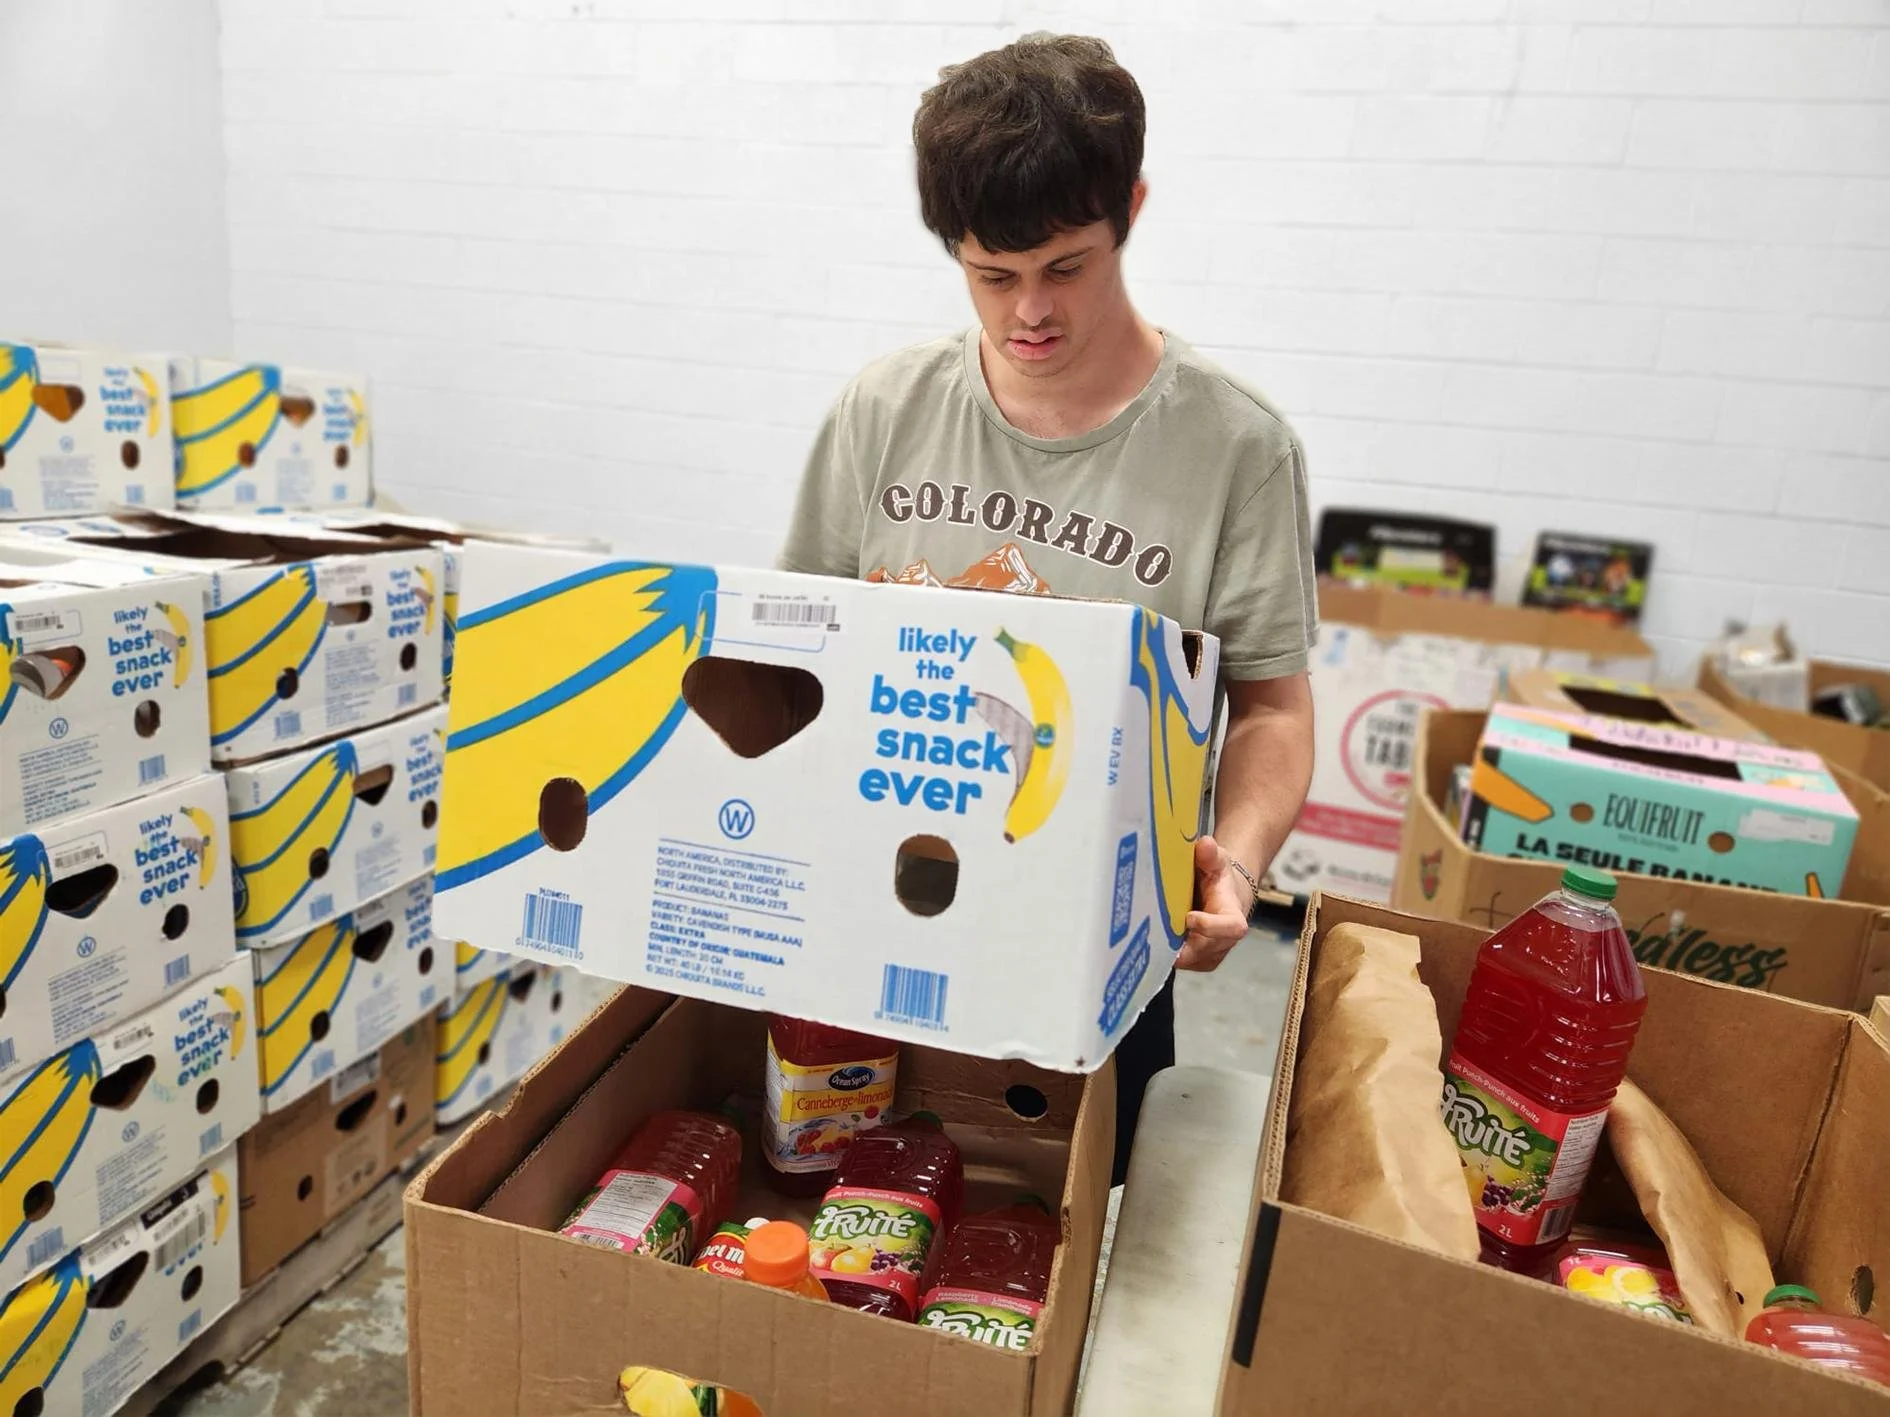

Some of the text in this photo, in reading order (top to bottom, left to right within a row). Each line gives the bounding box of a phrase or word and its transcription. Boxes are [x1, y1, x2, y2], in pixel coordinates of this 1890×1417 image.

[880, 481, 1173, 587] COLORADO
[114, 606, 148, 624] likely
[108, 630, 154, 656] best
[898, 627, 978, 661] likely
[116, 646, 172, 674] snack
[916, 660, 954, 680] the
[112, 671, 164, 696] ever
[870, 674, 977, 724] best
[876, 728, 1012, 774] snack
[859, 768, 982, 814] ever
[140, 814, 172, 834] likely
[1603, 793, 1706, 845] EQUIFRUIT
[134, 836, 180, 867] best
[143, 848, 198, 884] snack
[1515, 833, 1551, 856] LA
[1555, 841, 1646, 874] SEULE
[140, 873, 190, 905] ever
[179, 996, 208, 1021] likely
[174, 1016, 216, 1052] best
[181, 1028, 229, 1066] snack
[178, 1049, 224, 1086] ever
[832, 1072, 870, 1087] Ocean Spray
[797, 1094, 854, 1112] Canneberge
[1506, 1096, 1520, 1108] aux
[1520, 1104, 1541, 1124] fruits
[712, 1260, 744, 1278] Qualit
